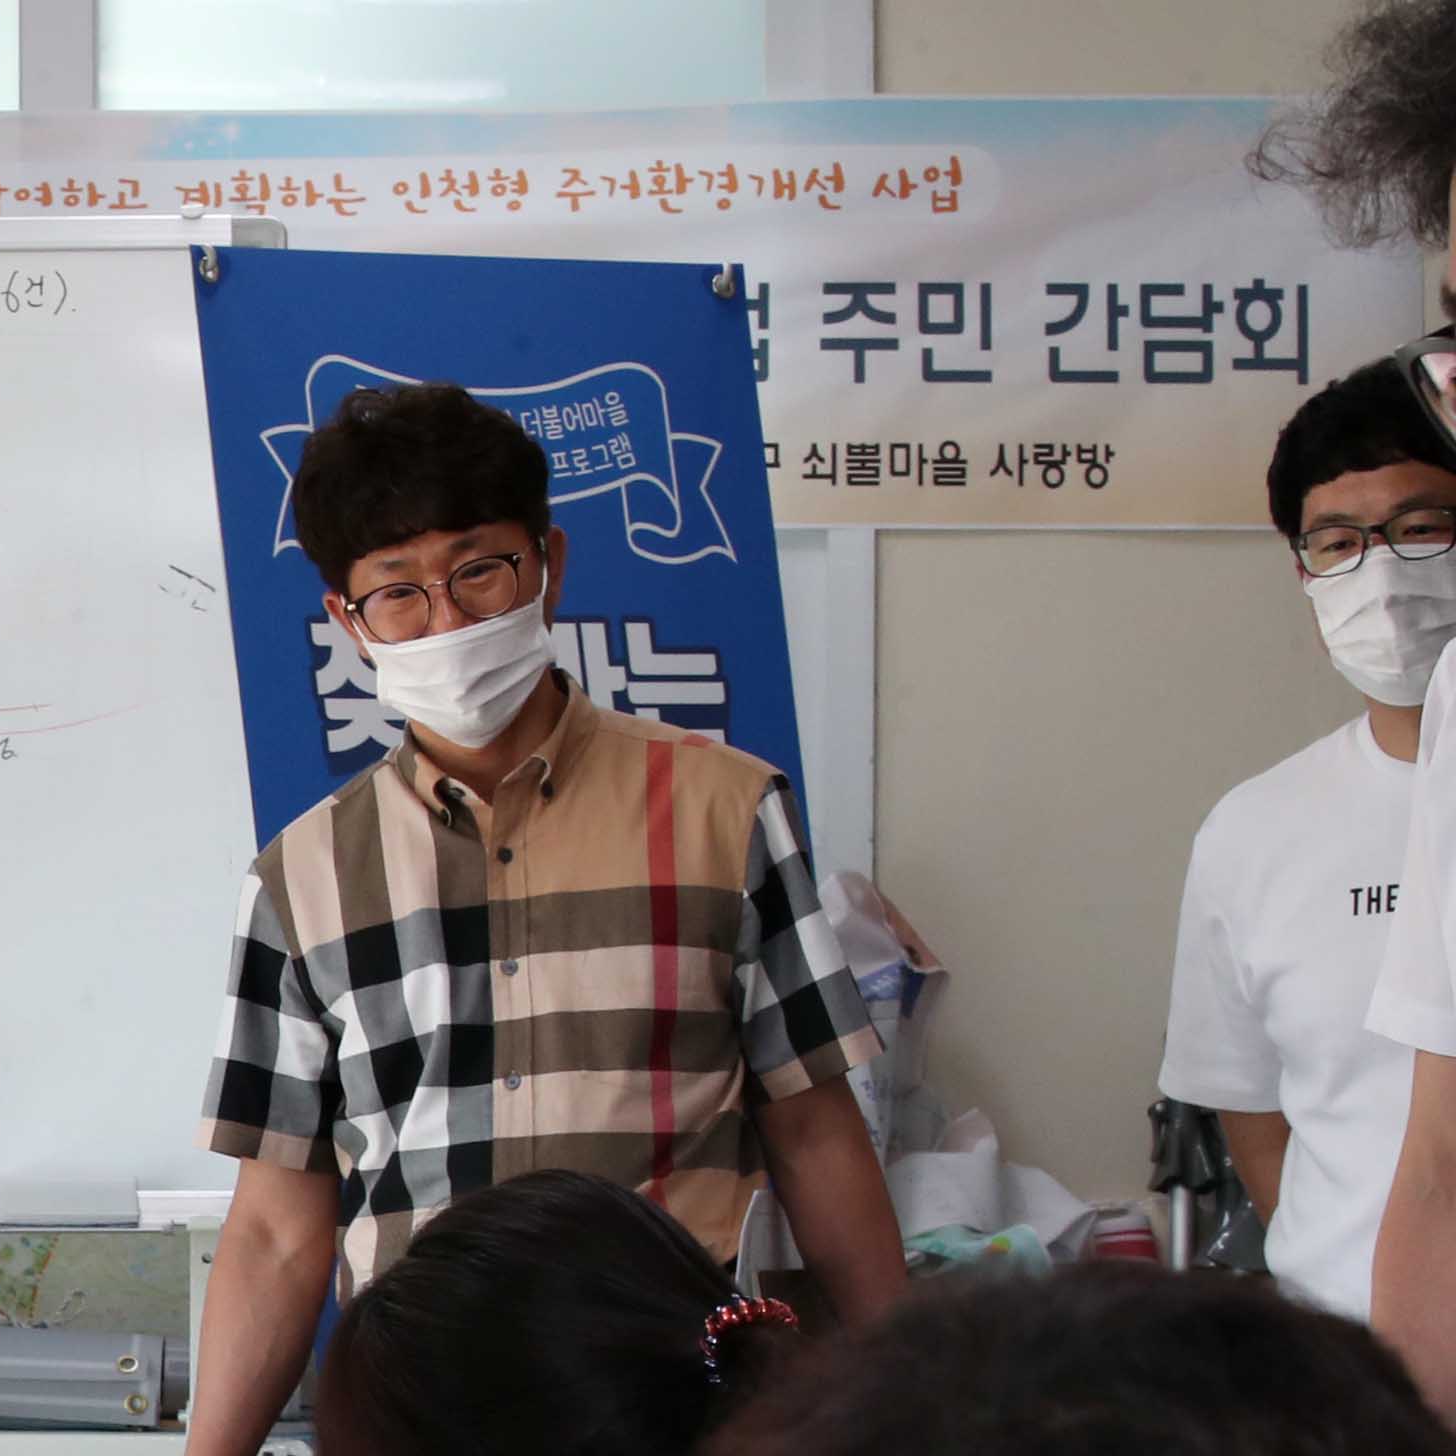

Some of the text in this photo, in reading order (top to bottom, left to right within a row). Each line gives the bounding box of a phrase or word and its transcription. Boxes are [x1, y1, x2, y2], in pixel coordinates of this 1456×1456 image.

[177, 172, 368, 220] 계획하는
[390, 166, 530, 215] 인천형
[555, 159, 847, 214] 주거환경개선
[871, 154, 964, 214] 사업
[820, 281, 992, 384] 주민
[1044, 275, 1309, 385] 간담회
[519, 391, 630, 440] 더불어마을
[551, 432, 637, 478] 프로그램
[802, 440, 969, 487] 쇠뿔마을
[989, 443, 1116, 489] 사랑방
[1350, 884, 1400, 916] THE
